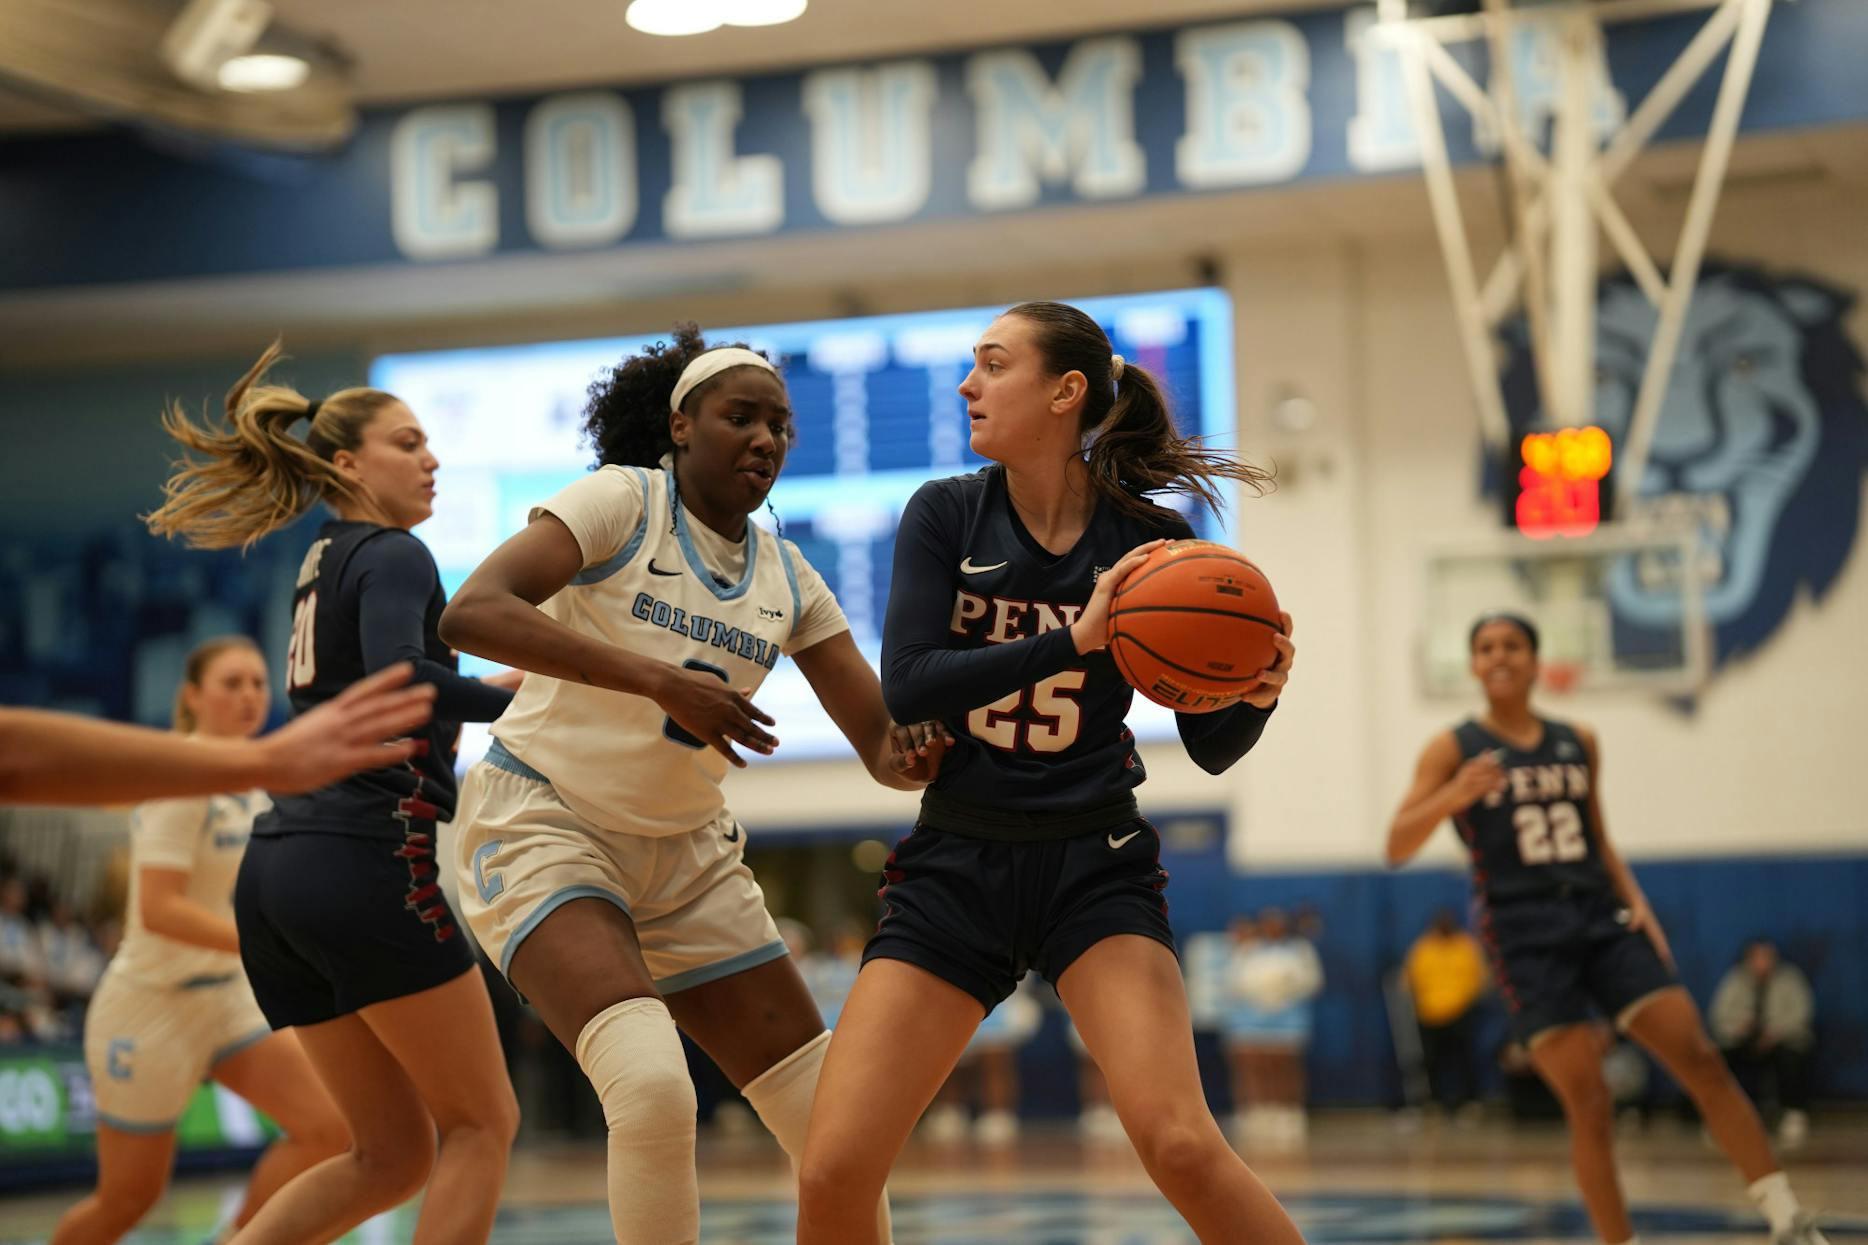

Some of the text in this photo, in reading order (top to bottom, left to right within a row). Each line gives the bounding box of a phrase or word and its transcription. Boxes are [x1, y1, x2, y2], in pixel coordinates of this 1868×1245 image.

[949, 590, 1105, 650] PEN
[967, 669, 1086, 753] 25
[1485, 763, 1590, 808] ENN
[1512, 801, 1588, 866] 22
